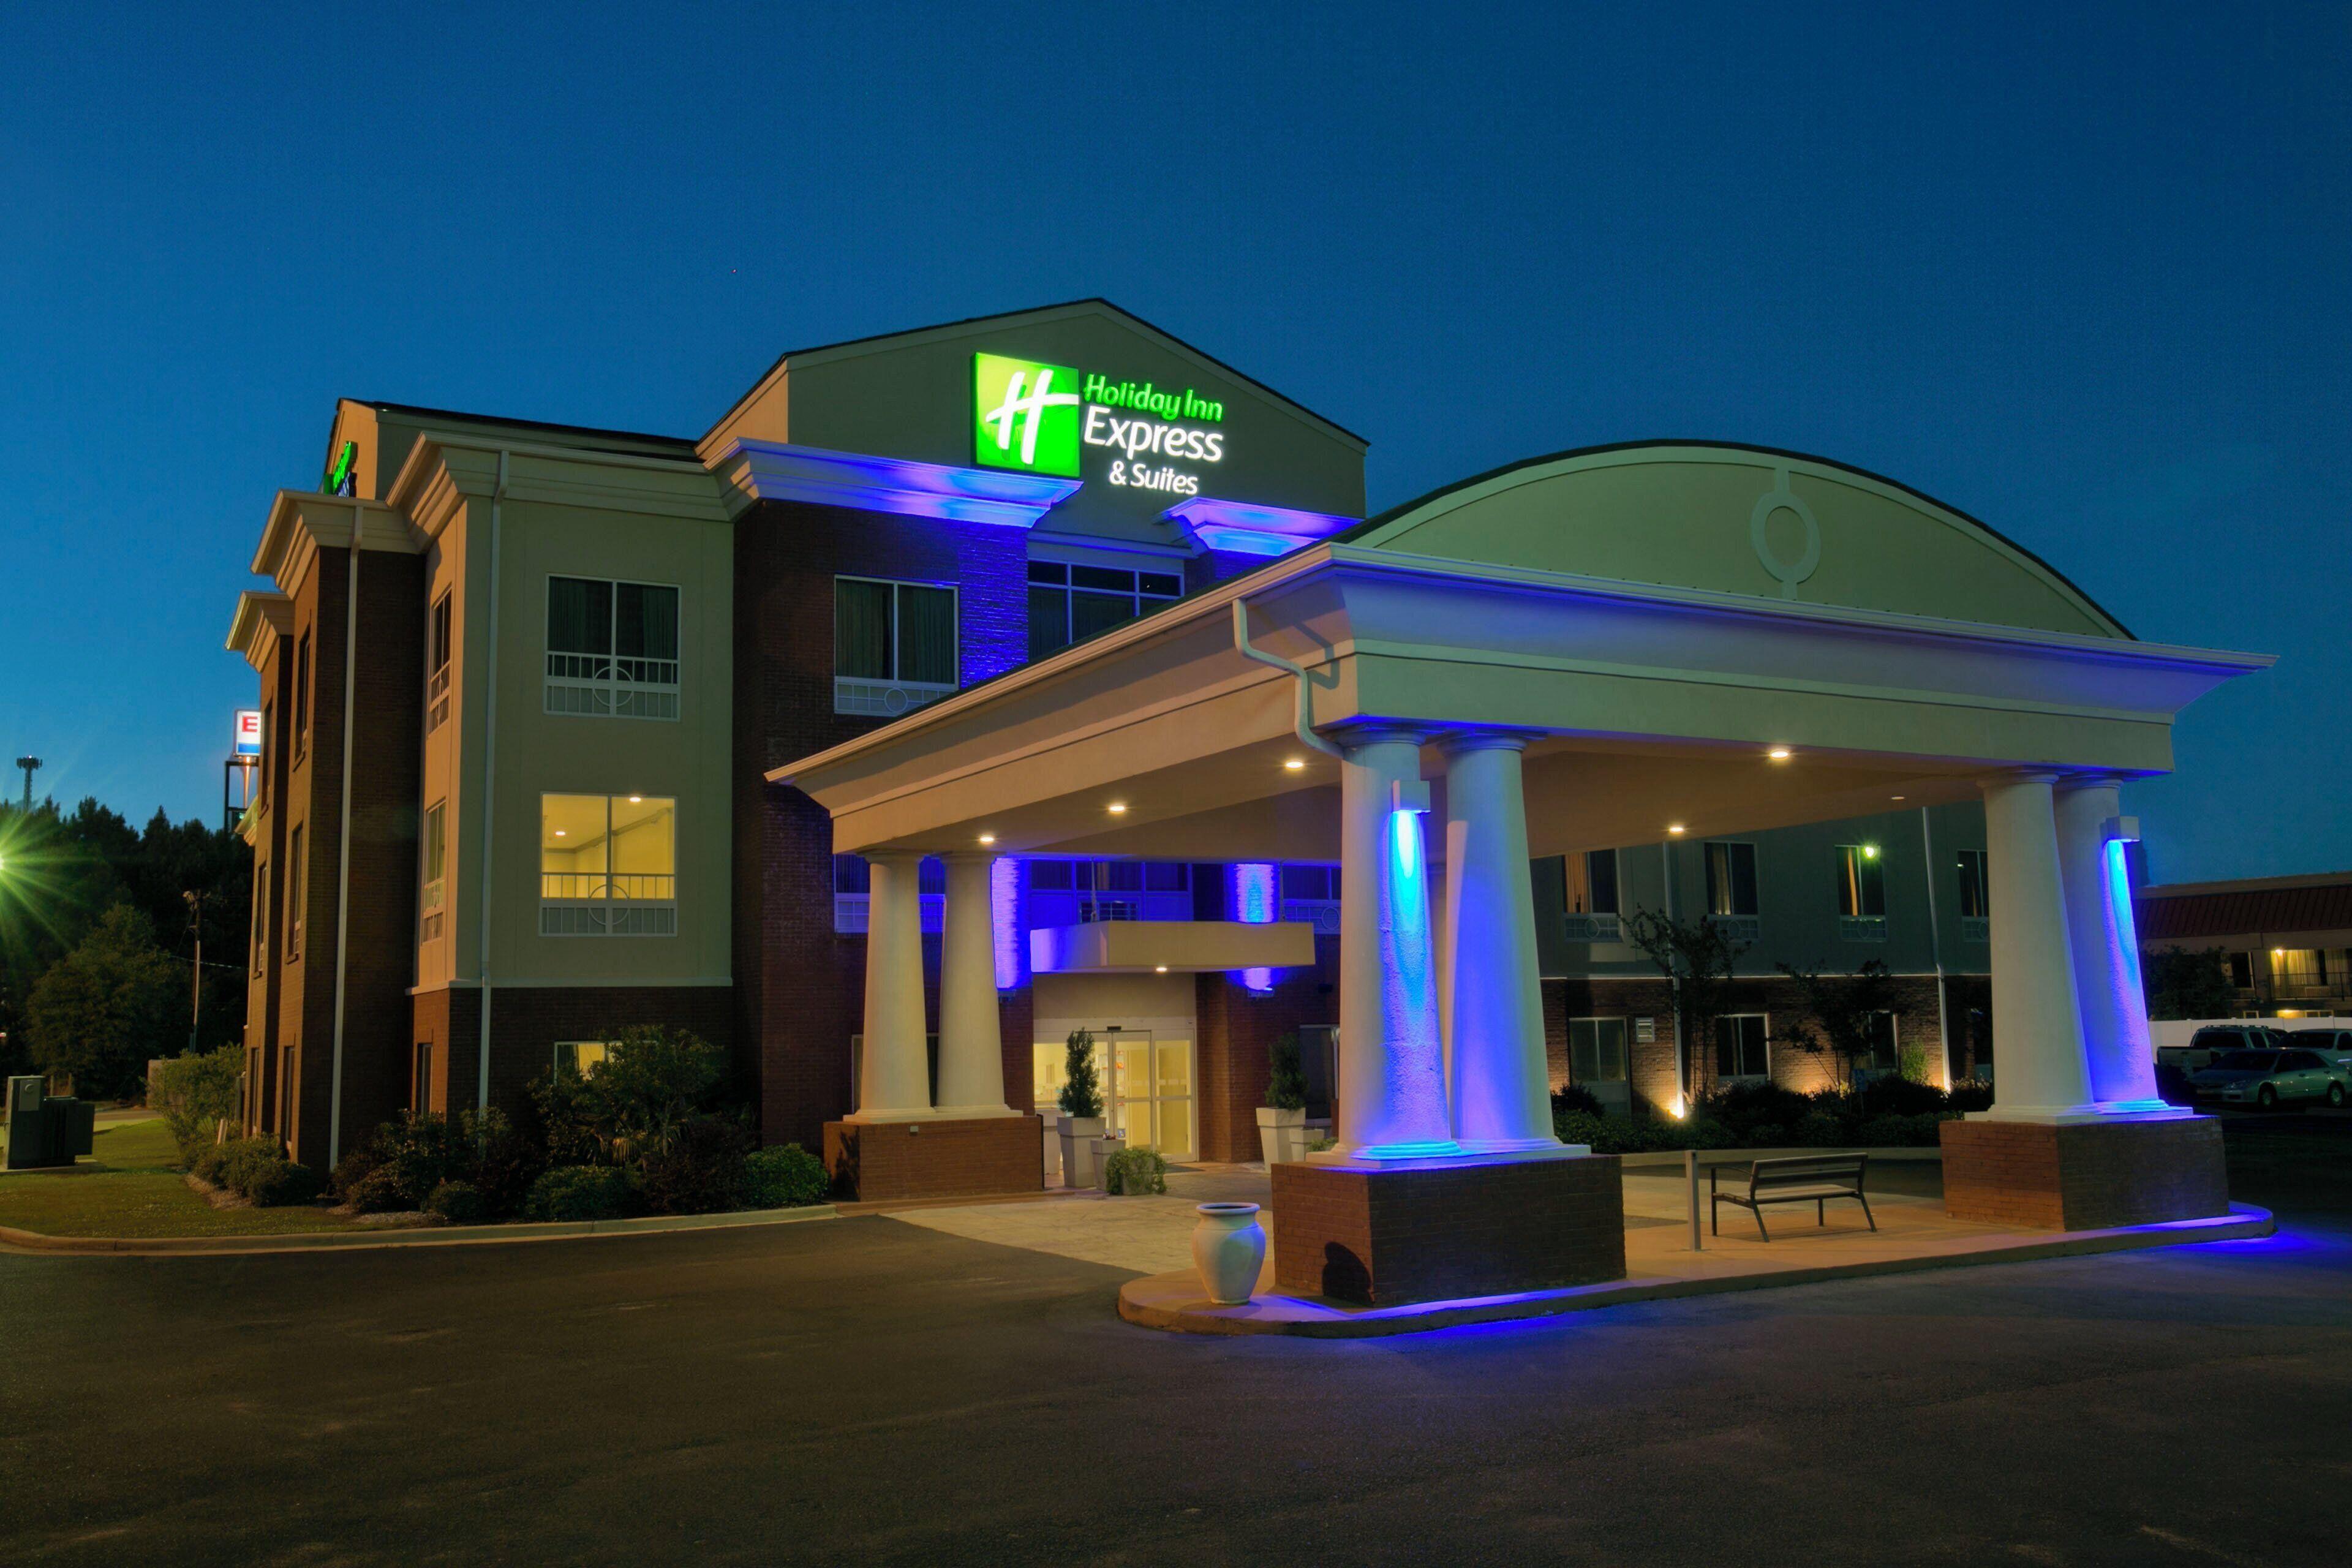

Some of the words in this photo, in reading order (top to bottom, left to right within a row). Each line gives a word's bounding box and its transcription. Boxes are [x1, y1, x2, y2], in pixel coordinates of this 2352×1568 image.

[1083, 374, 1180, 420] Holiday
[1184, 389, 1223, 421] Inn
[1084, 405, 1223, 462] Express
[1109, 461, 1127, 486] &
[1130, 463, 1199, 496] Suites
[242, 715, 258, 732] E
